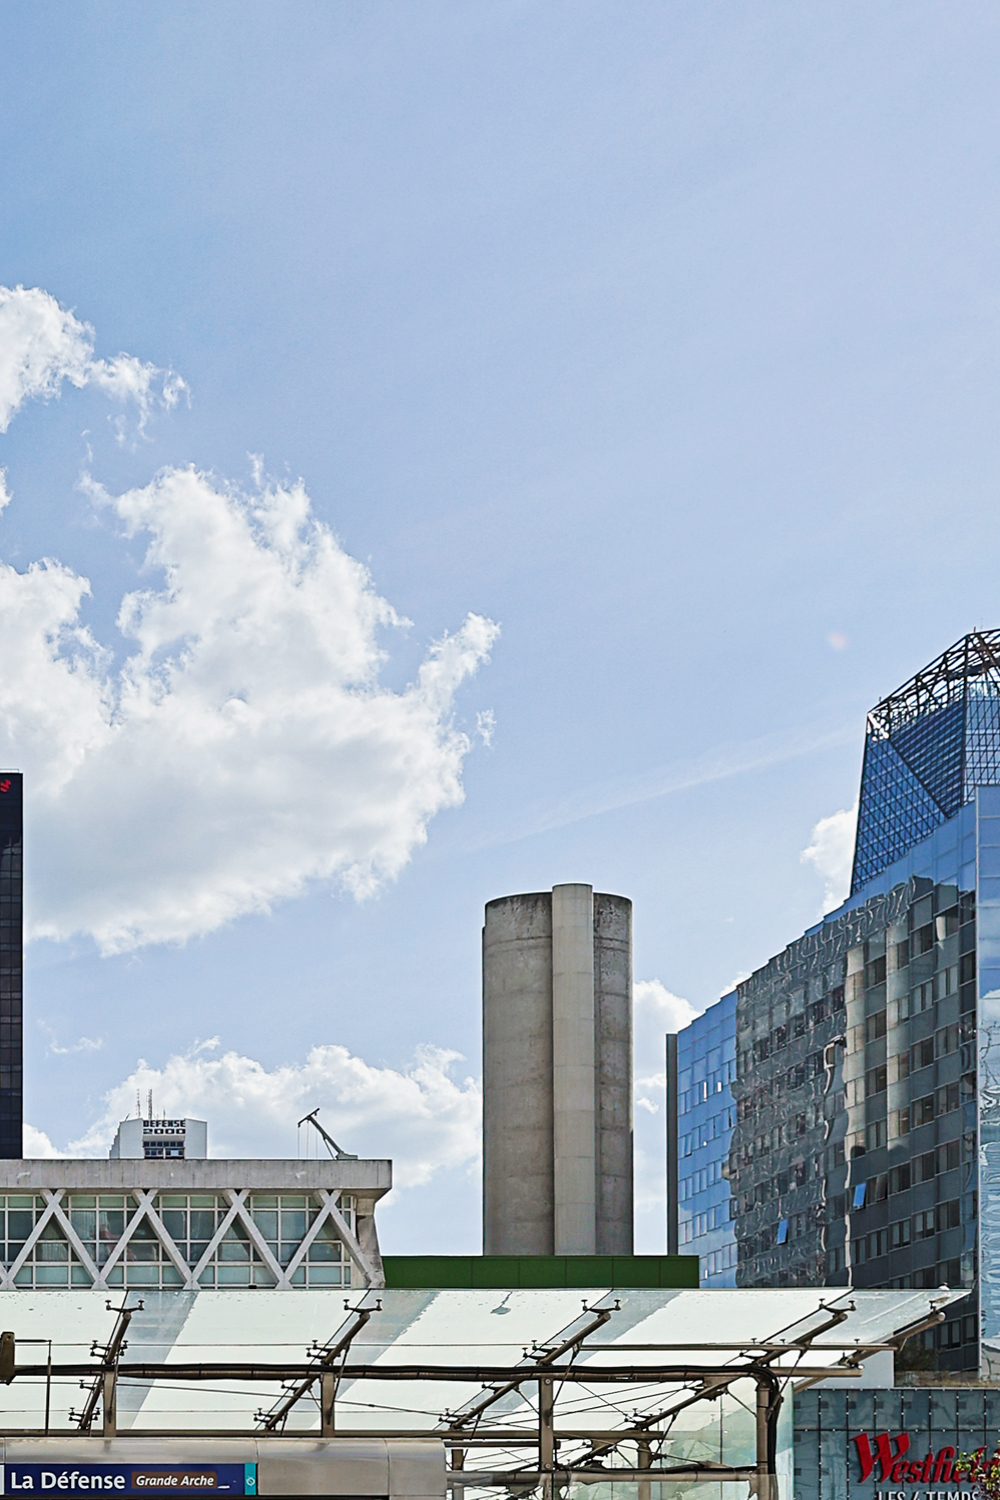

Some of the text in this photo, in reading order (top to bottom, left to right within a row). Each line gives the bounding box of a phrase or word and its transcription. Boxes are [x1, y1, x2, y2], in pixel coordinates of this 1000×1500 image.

[142, 1119, 186, 1128] DEFENSE
[10, 1470, 126, 1489] La Défense
[136, 1474, 214, 1486] Grande Arche
